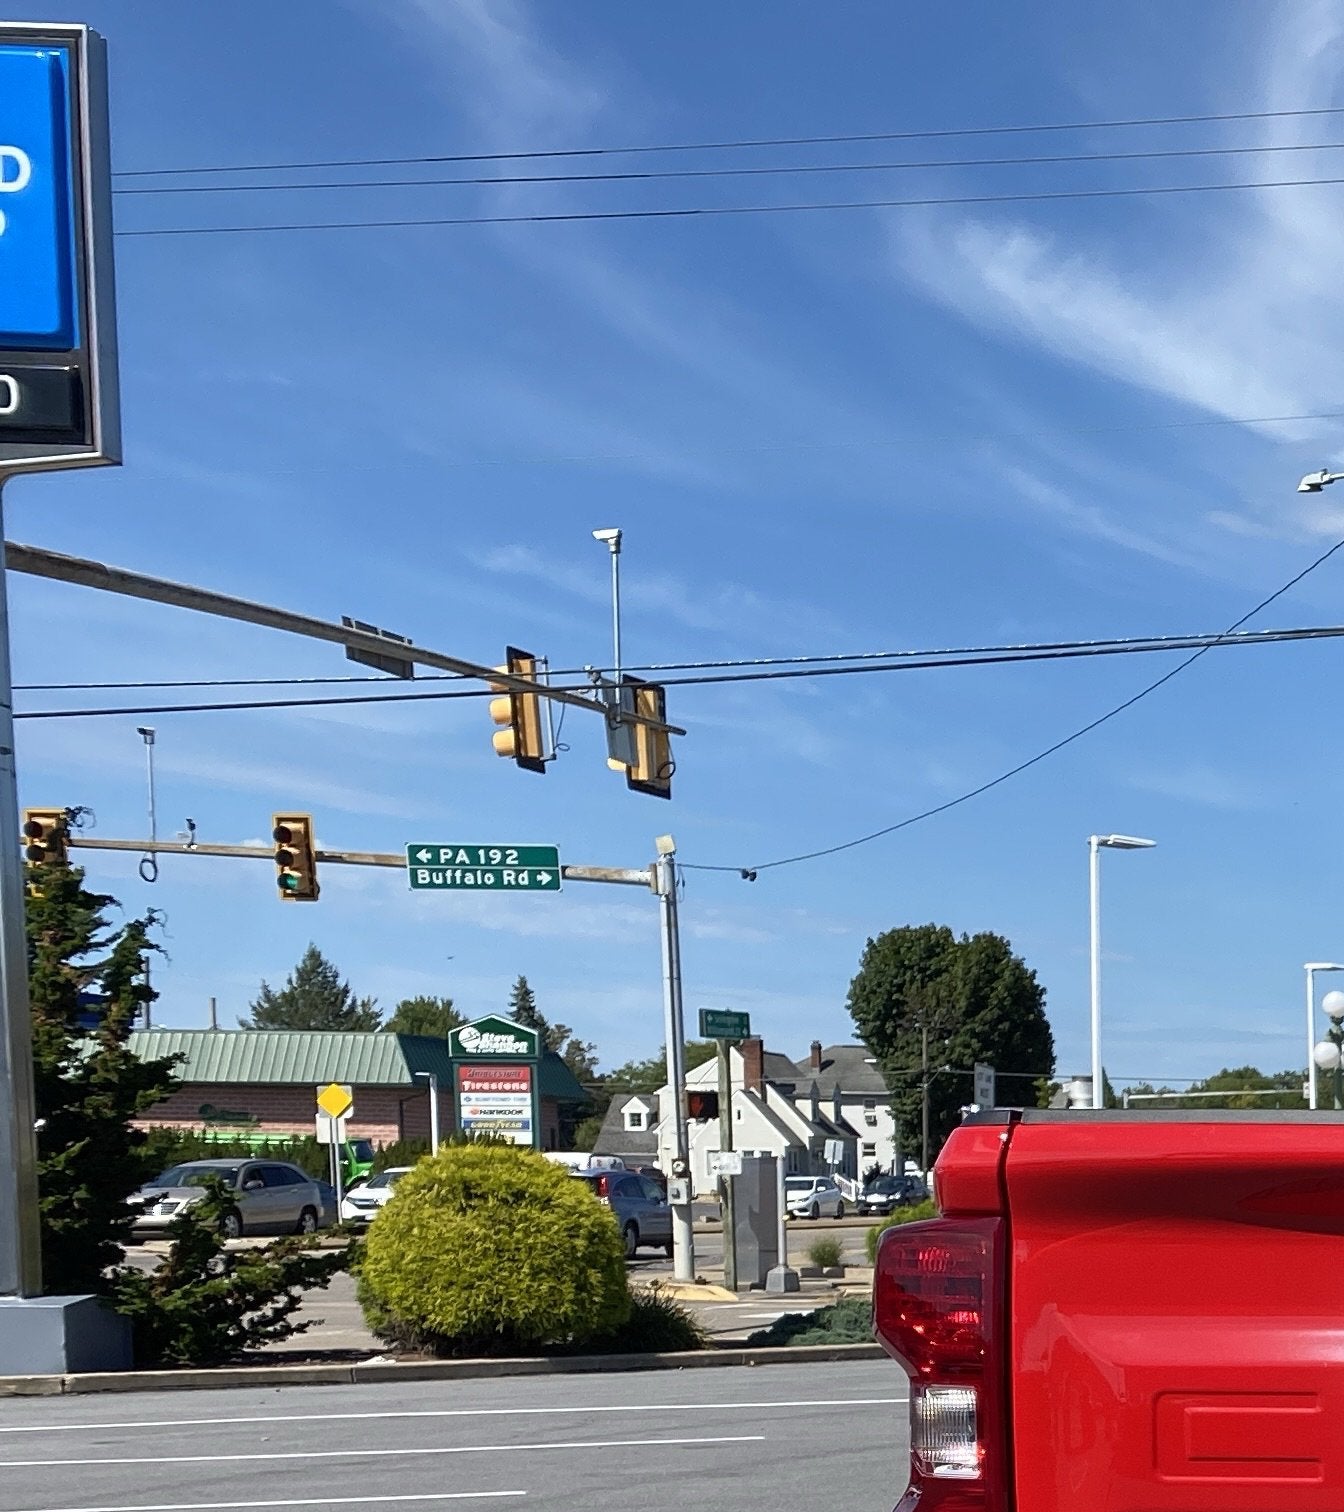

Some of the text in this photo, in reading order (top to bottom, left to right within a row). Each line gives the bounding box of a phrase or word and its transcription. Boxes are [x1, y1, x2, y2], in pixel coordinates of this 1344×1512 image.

[439, 848, 519, 865] PA 192
[416, 869, 529, 886] Buffalo Rd
[462, 1080, 528, 1091] Firestone
